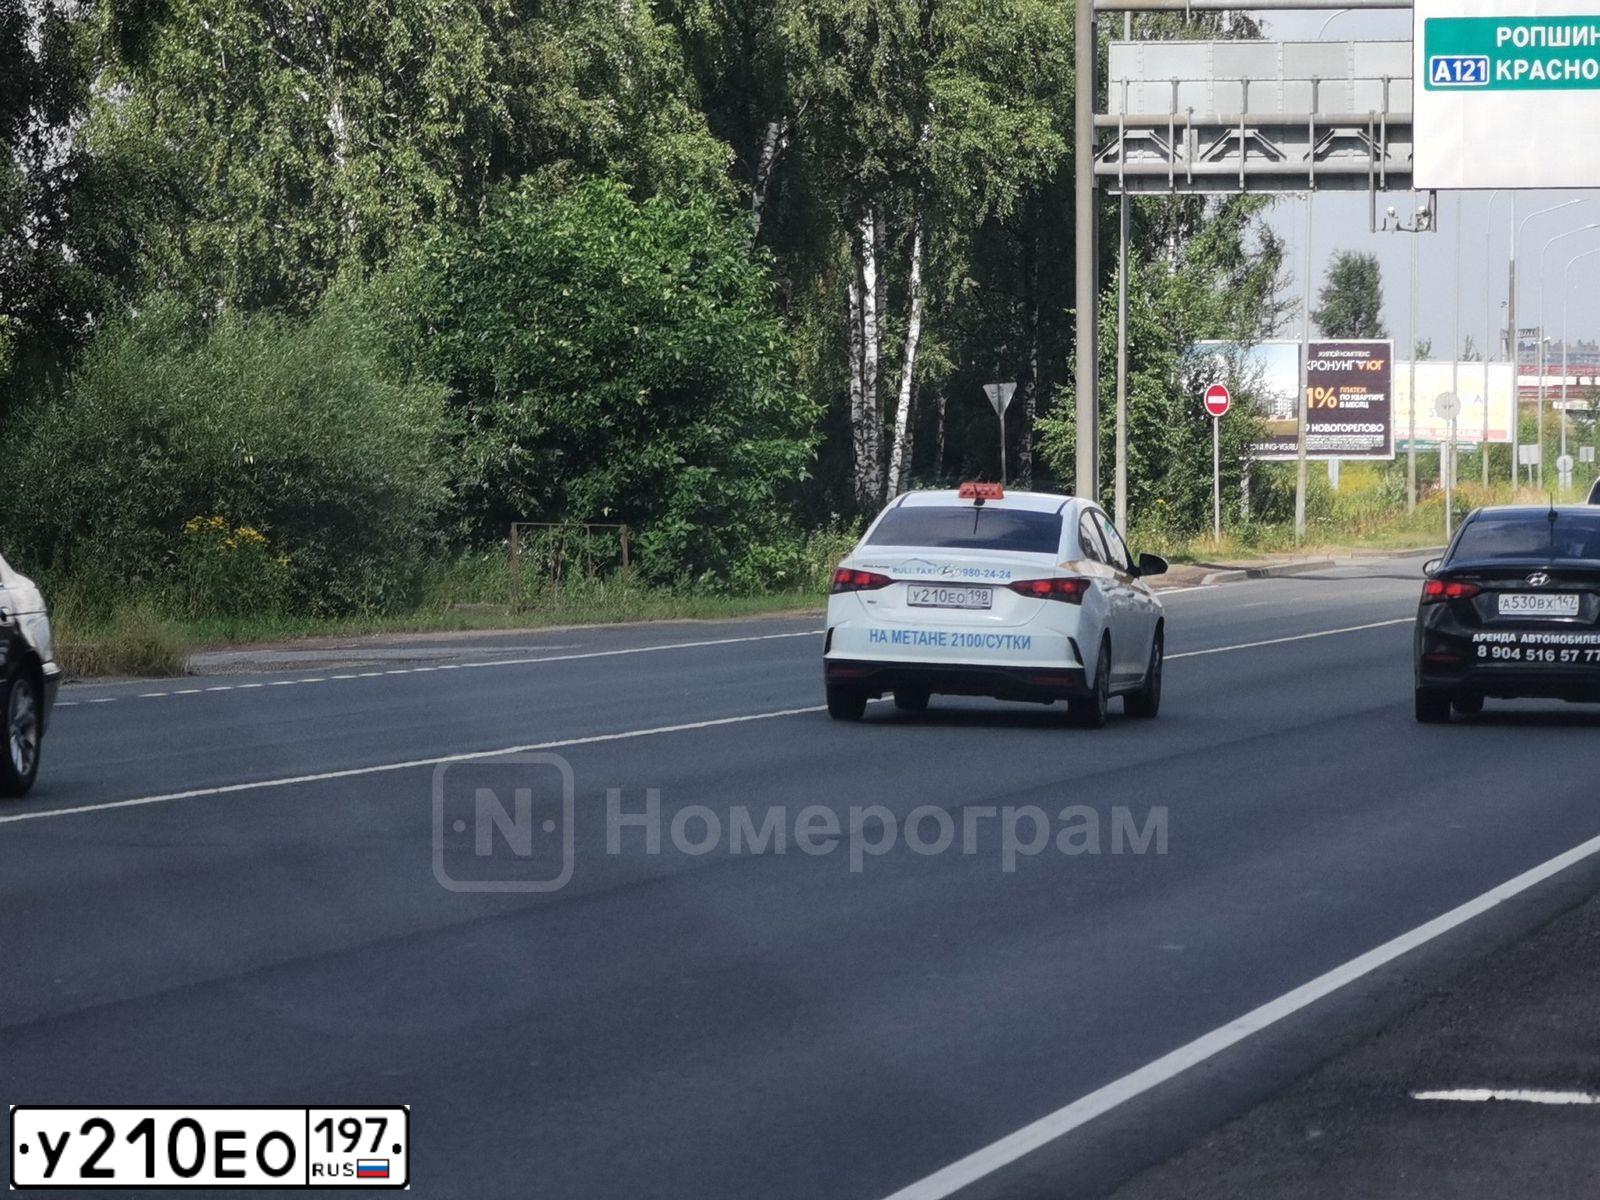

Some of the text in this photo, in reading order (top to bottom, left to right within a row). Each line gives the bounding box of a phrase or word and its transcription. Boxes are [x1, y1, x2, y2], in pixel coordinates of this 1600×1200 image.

[1434, 60, 1487, 82] А121
[1306, 387, 1337, 408] 1%
[1311, 424, 1385, 433] НОВОГОРЕЛОВО
[962, 570, 1011, 579] 980-24-24
[969, 592, 989, 601] 198
[870, 629, 1031, 650] НА МЕТАНЕ 2100/СУТКИ
[1472, 633, 1516, 643] АРЕНДА
[1477, 645, 1487, 657] 8
[1491, 646, 1520, 660] 904
[1526, 649, 1555, 661] 516
[1560, 649, 1580, 661] 57
